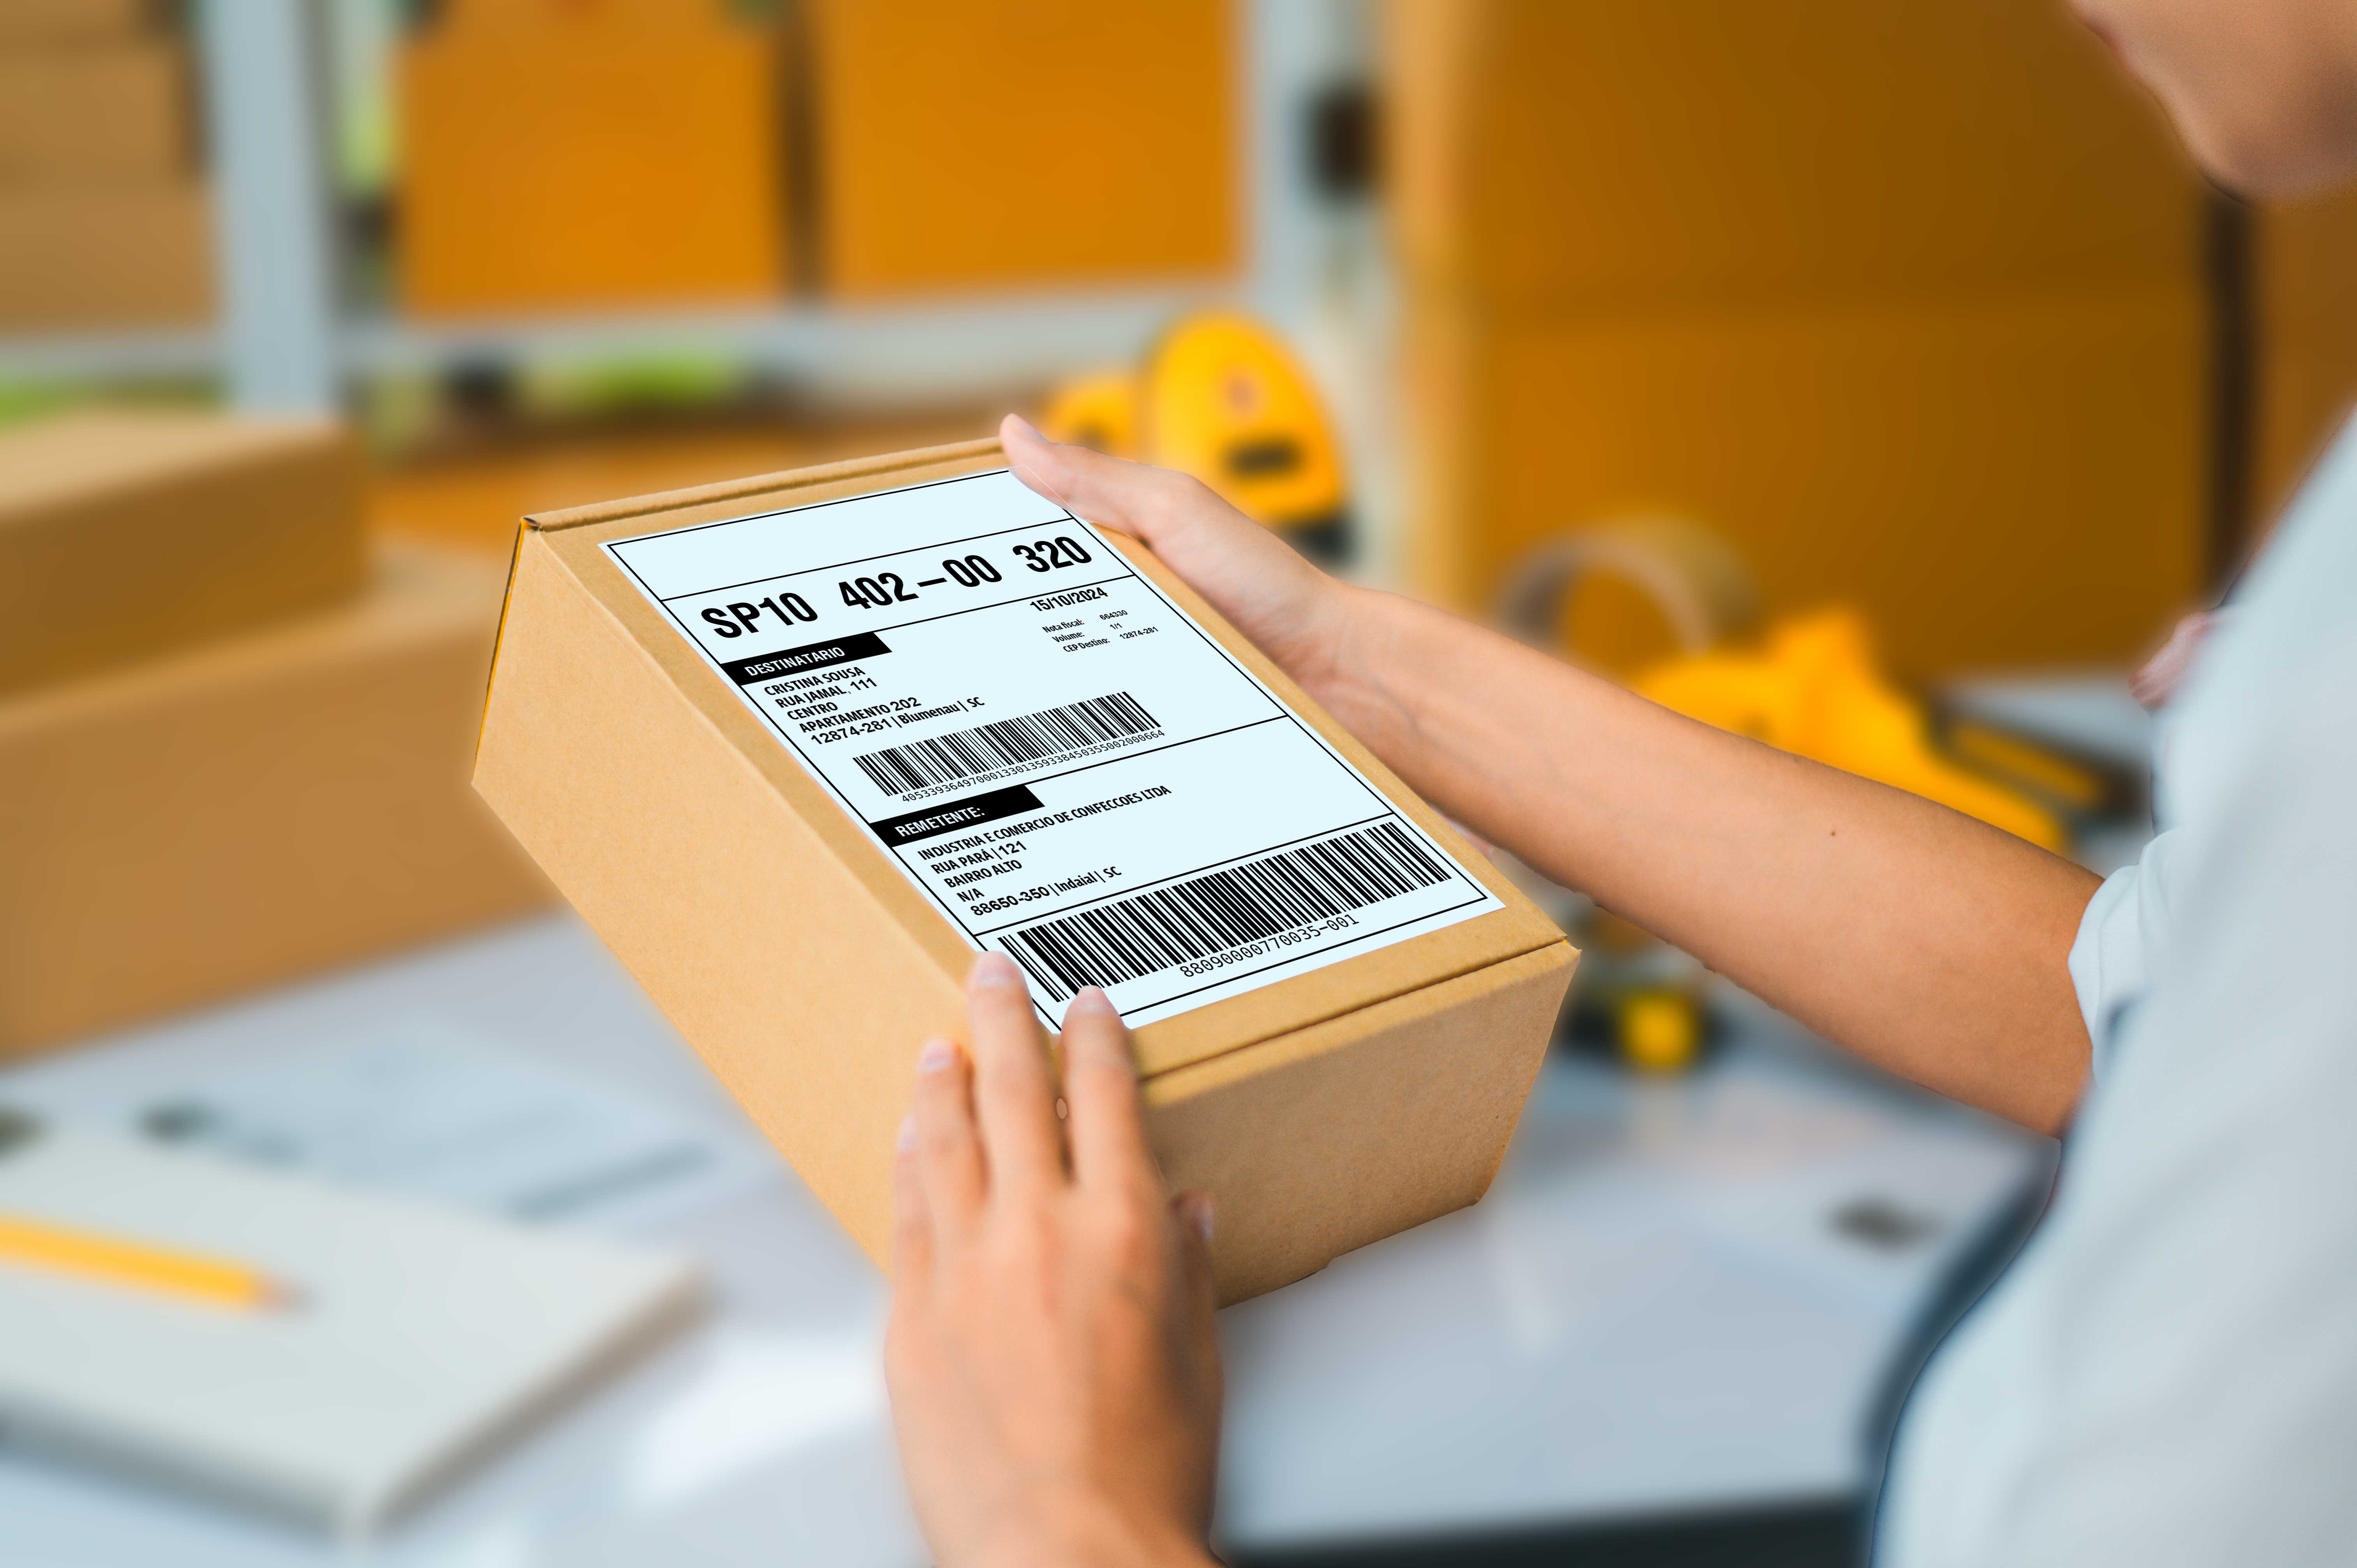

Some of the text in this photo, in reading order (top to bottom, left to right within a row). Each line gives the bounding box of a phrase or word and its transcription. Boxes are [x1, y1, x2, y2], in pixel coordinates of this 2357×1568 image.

[701, 592, 818, 638] SP10
[1012, 536, 1092, 572] 320
[1030, 587, 1108, 611] 15/10/2024
[1060, 619, 1085, 629] fiscal:
[1099, 610, 1128, 620] 664330
[1051, 632, 1085, 643] Volume:
[1063, 626, 1159, 652] CEP Destino: 12874-281
[744, 647, 845, 676] DESTINATARIO
[764, 667, 866, 696] CRISTINA SOUSA
[775, 678, 877, 708] RUA JAMAL, 111
[787, 702, 838, 720] CENTRO
[799, 697, 922, 733] APARTAMENTO 202
[811, 718, 892, 745] 12874-281
[897, 704, 961, 724] Blumenau
[966, 697, 985, 708] SC
[902, 729, 1165, 802] 4053393649700013301359338450355002000664
[894, 807, 985, 837] REMETENTE:
[917, 786, 1172, 860] INDUSTRIA E COMERCIO DE CONFECCOES LTDA
[930, 860, 961, 874] RUA
[957, 849, 995, 867] PARÁ
[998, 841, 1027, 855] 121
[944, 860, 1022, 888] BAIRRO ALTO
[956, 888, 985, 902] N/A
[970, 886, 1050, 916] 88650-350
[1053, 872, 1098, 892] Indaial
[1103, 866, 1122, 878] SC
[1180, 914, 1360, 977] 88090000770035-001
